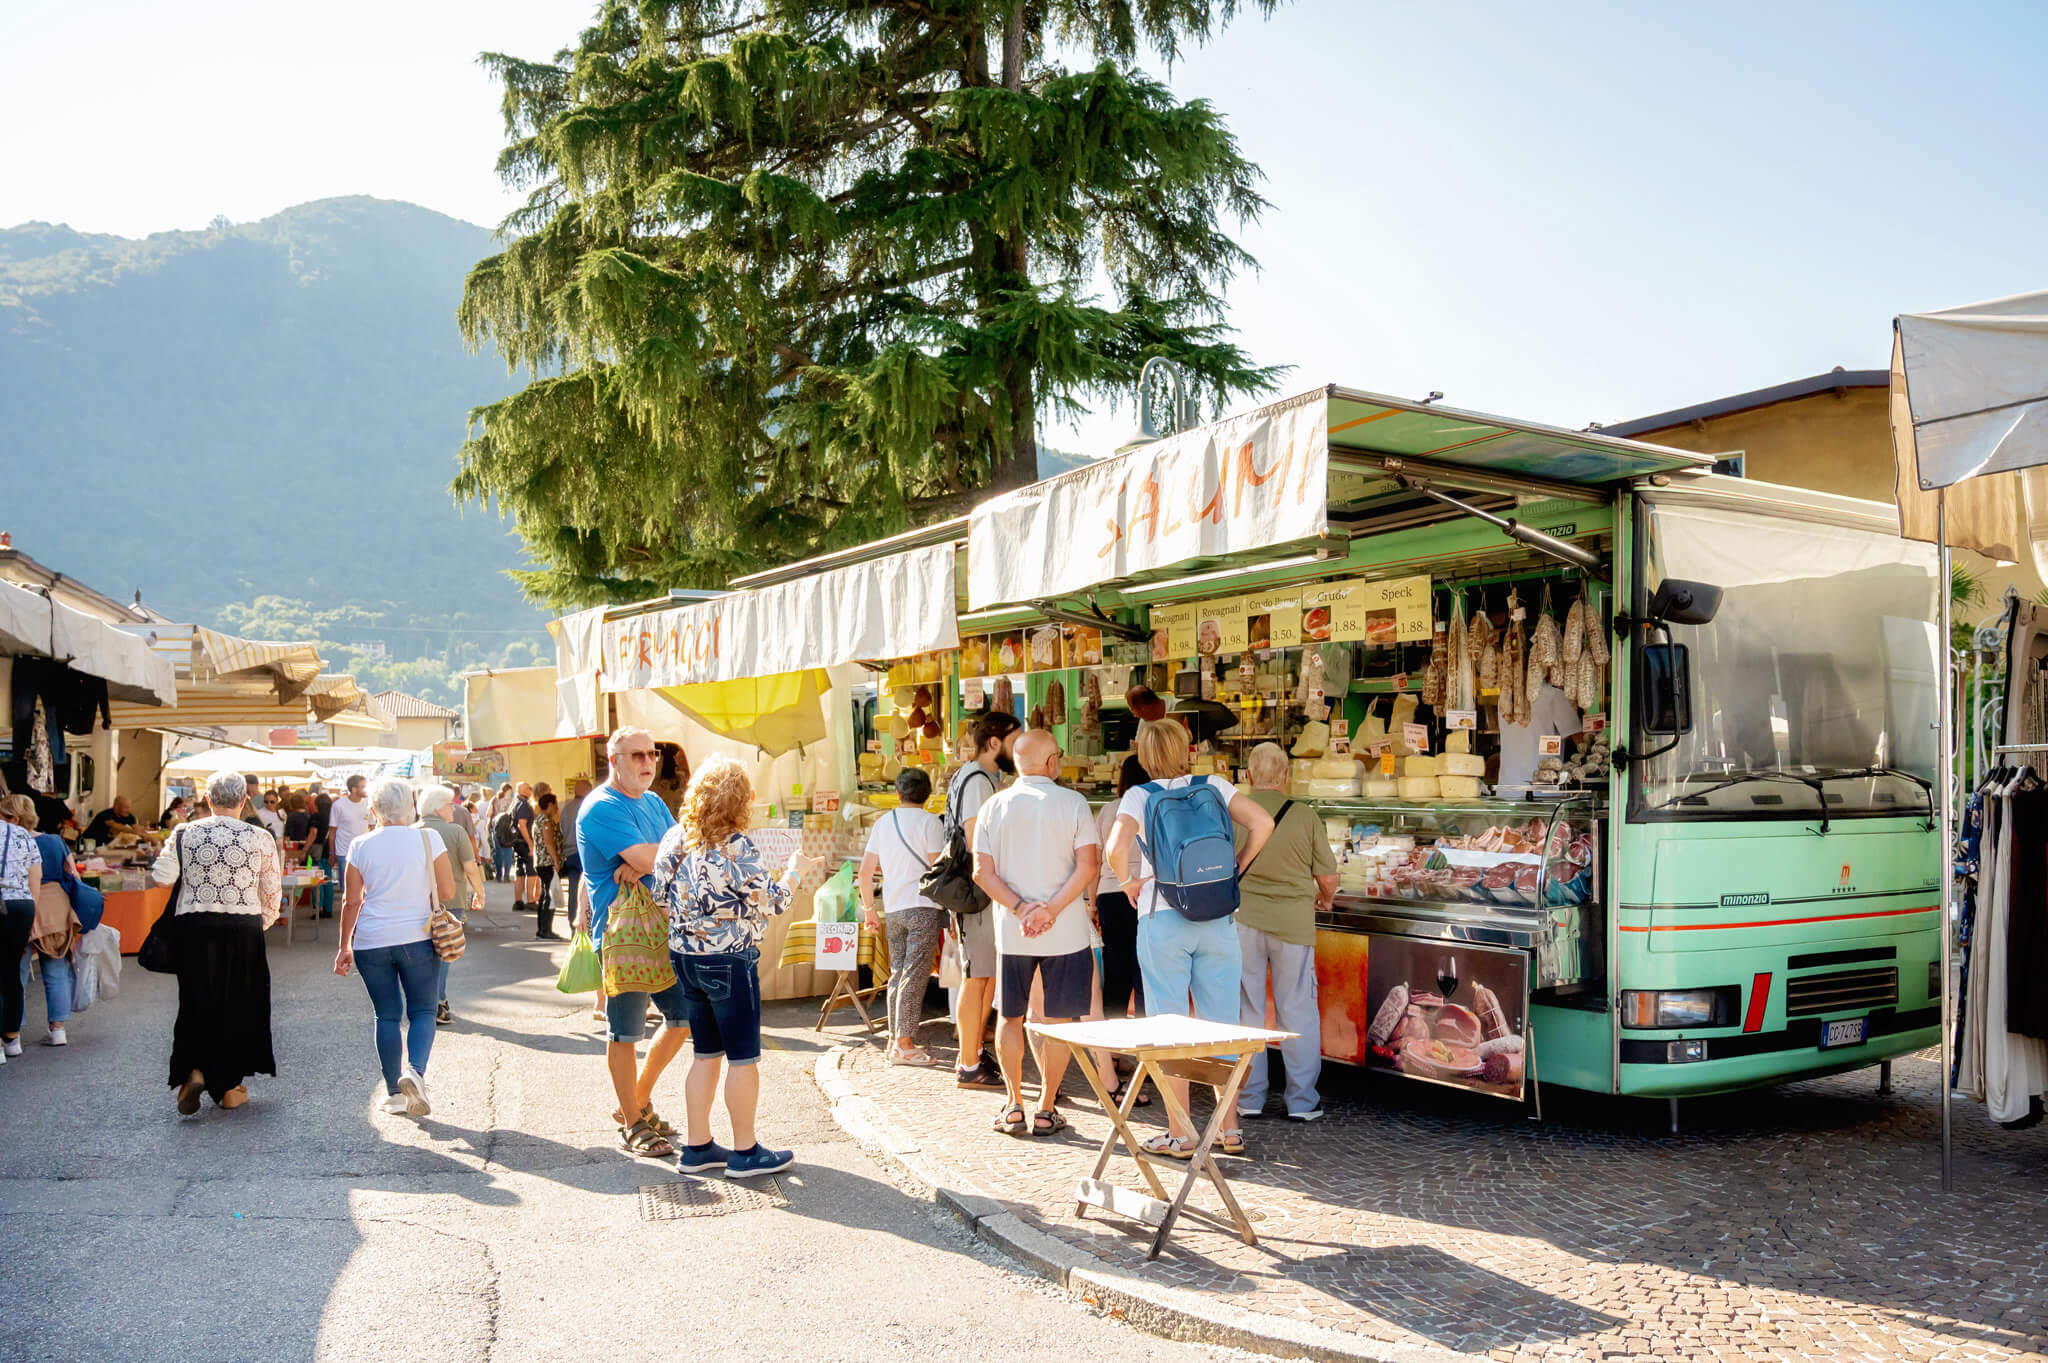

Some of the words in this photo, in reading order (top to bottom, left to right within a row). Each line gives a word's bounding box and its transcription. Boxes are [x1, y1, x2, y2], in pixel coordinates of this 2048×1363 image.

[1317, 589, 1348, 602] Crudo
[1381, 586, 1413, 602] Speck
[1202, 603, 1241, 618] Rovagnati
[1154, 612, 1190, 625] Rovagnati
[619, 616, 720, 672] FORMAGGI
[1723, 894, 1767, 906] minonzio
